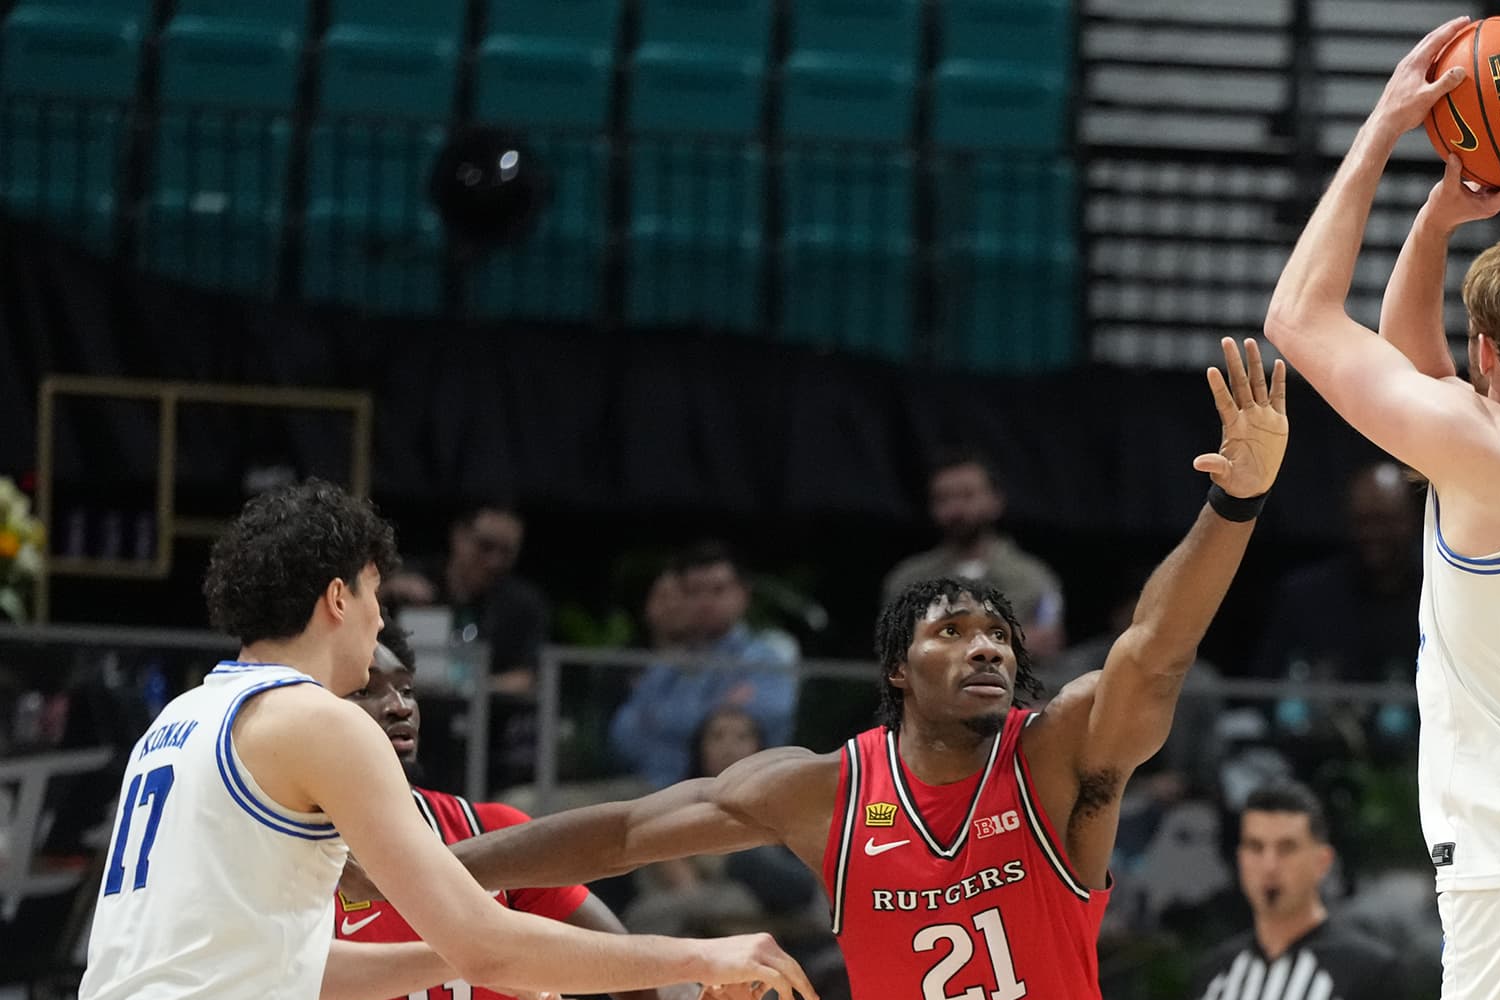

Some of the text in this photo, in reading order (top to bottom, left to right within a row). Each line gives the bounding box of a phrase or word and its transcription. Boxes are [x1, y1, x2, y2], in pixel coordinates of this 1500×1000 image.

[103, 764, 175, 897] 17
[973, 810, 1020, 840] BIG
[872, 860, 1026, 910] RUTGERS
